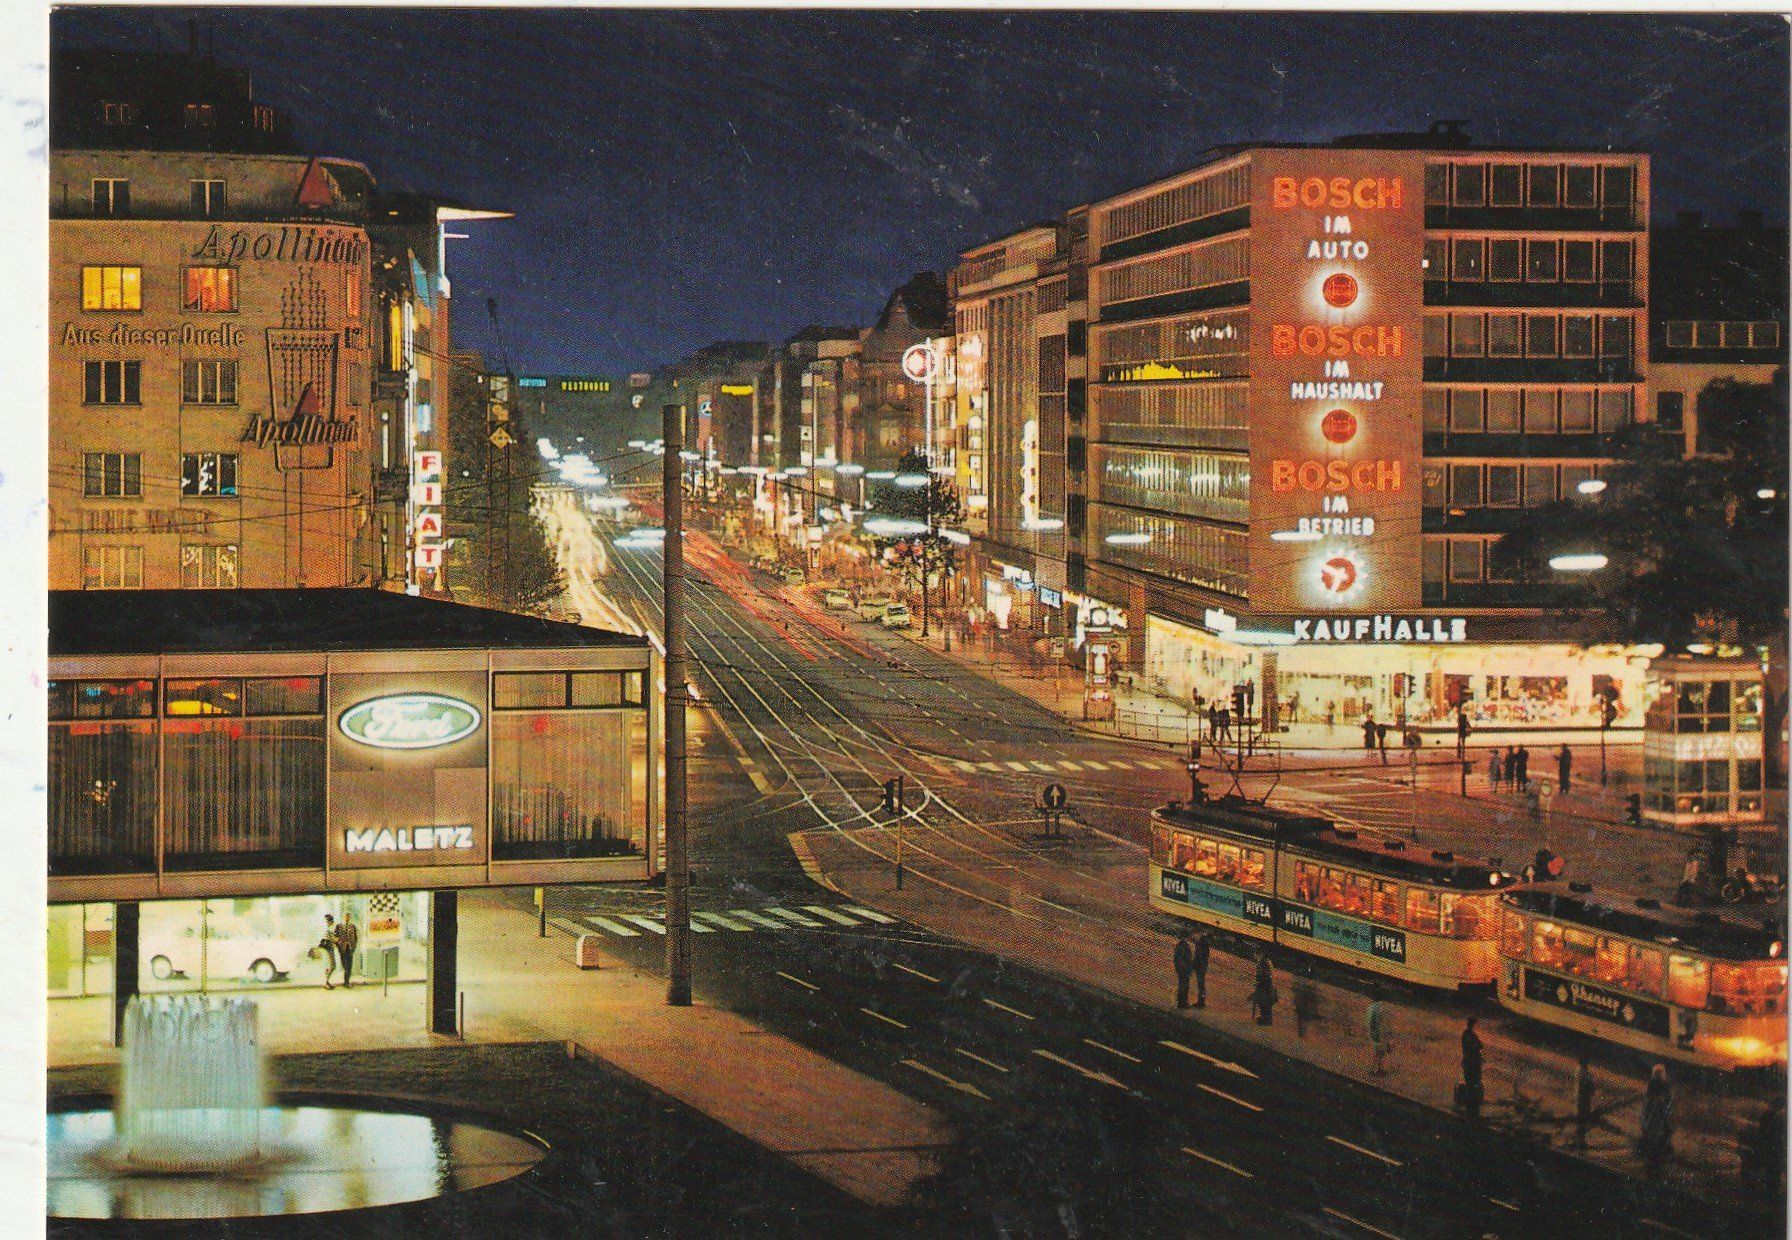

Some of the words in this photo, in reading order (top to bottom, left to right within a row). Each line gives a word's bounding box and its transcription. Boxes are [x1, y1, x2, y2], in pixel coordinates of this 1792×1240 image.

[1273, 177, 1406, 209] BOSCH
[1323, 215, 1351, 234] IM
[1307, 239, 1370, 260] AUTO
[62, 321, 101, 347] Aus
[109, 321, 182, 347] dieser
[1272, 325, 1406, 358] BOSCH
[1324, 360, 1350, 379] IM
[1291, 381, 1384, 401] HAUSHALT
[1272, 459, 1406, 492] BOSCH
[418, 453, 439, 564] FIAT
[1323, 495, 1349, 513] IM
[1298, 517, 1375, 536] BETRIEB
[1293, 614, 1467, 641] KAUFHALLE
[364, 700, 453, 739] Ford
[346, 826, 474, 852] MALETZ
[1245, 899, 1272, 919] NIVEA
[1284, 909, 1312, 930] NIVEA
